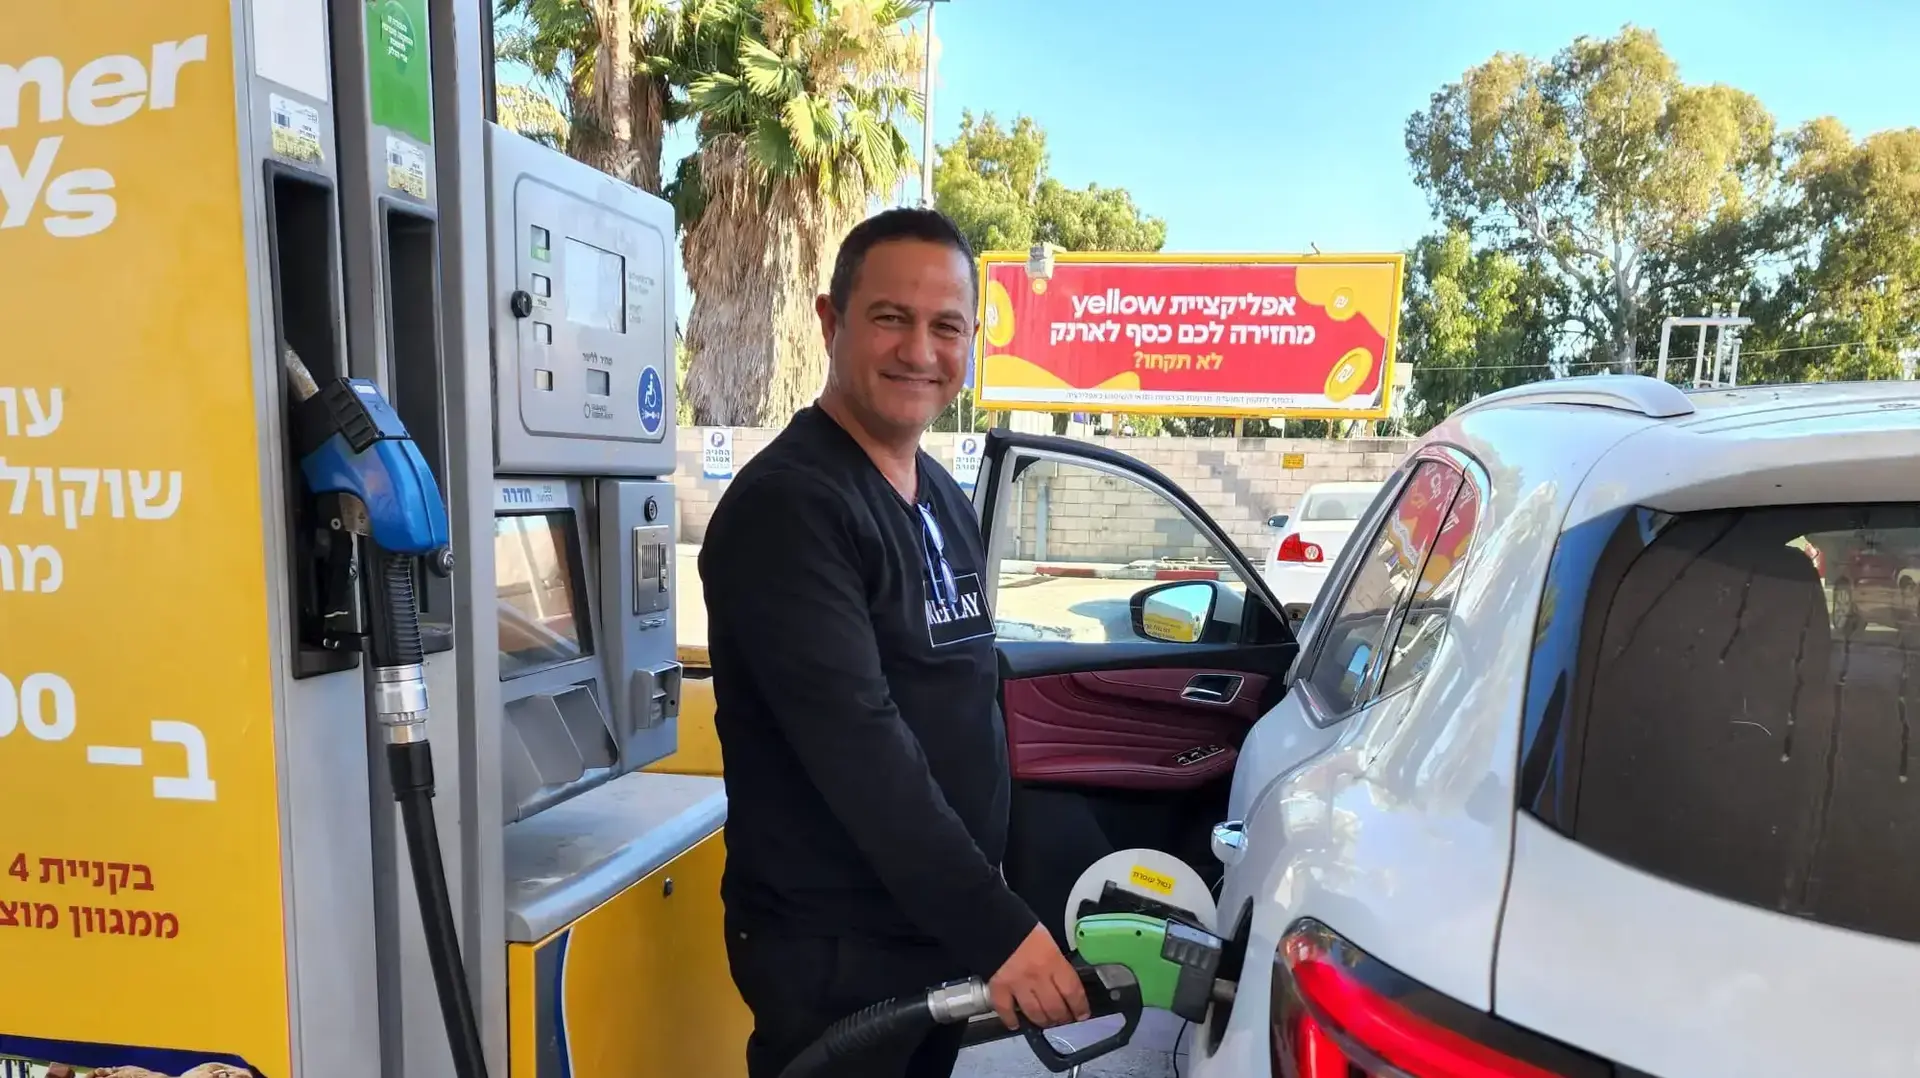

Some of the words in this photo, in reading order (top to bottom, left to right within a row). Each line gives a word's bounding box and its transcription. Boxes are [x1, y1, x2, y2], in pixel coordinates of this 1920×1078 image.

[1072, 288, 1166, 318] yellow
[1169, 293, 1296, 319] אפליקציית
[1050, 320, 1120, 346] לארנק
[1126, 322, 1172, 348] כסף
[1178, 319, 1224, 344] לכם
[1229, 324, 1315, 346] מחזירה
[1134, 352, 1191, 372] תקחו?
[1195, 351, 1223, 371] לא
[502, 487, 533, 503] חדרה
[9, 853, 30, 882] 4
[39, 857, 154, 895] בקניית
[69, 906, 179, 938] ממגוון
